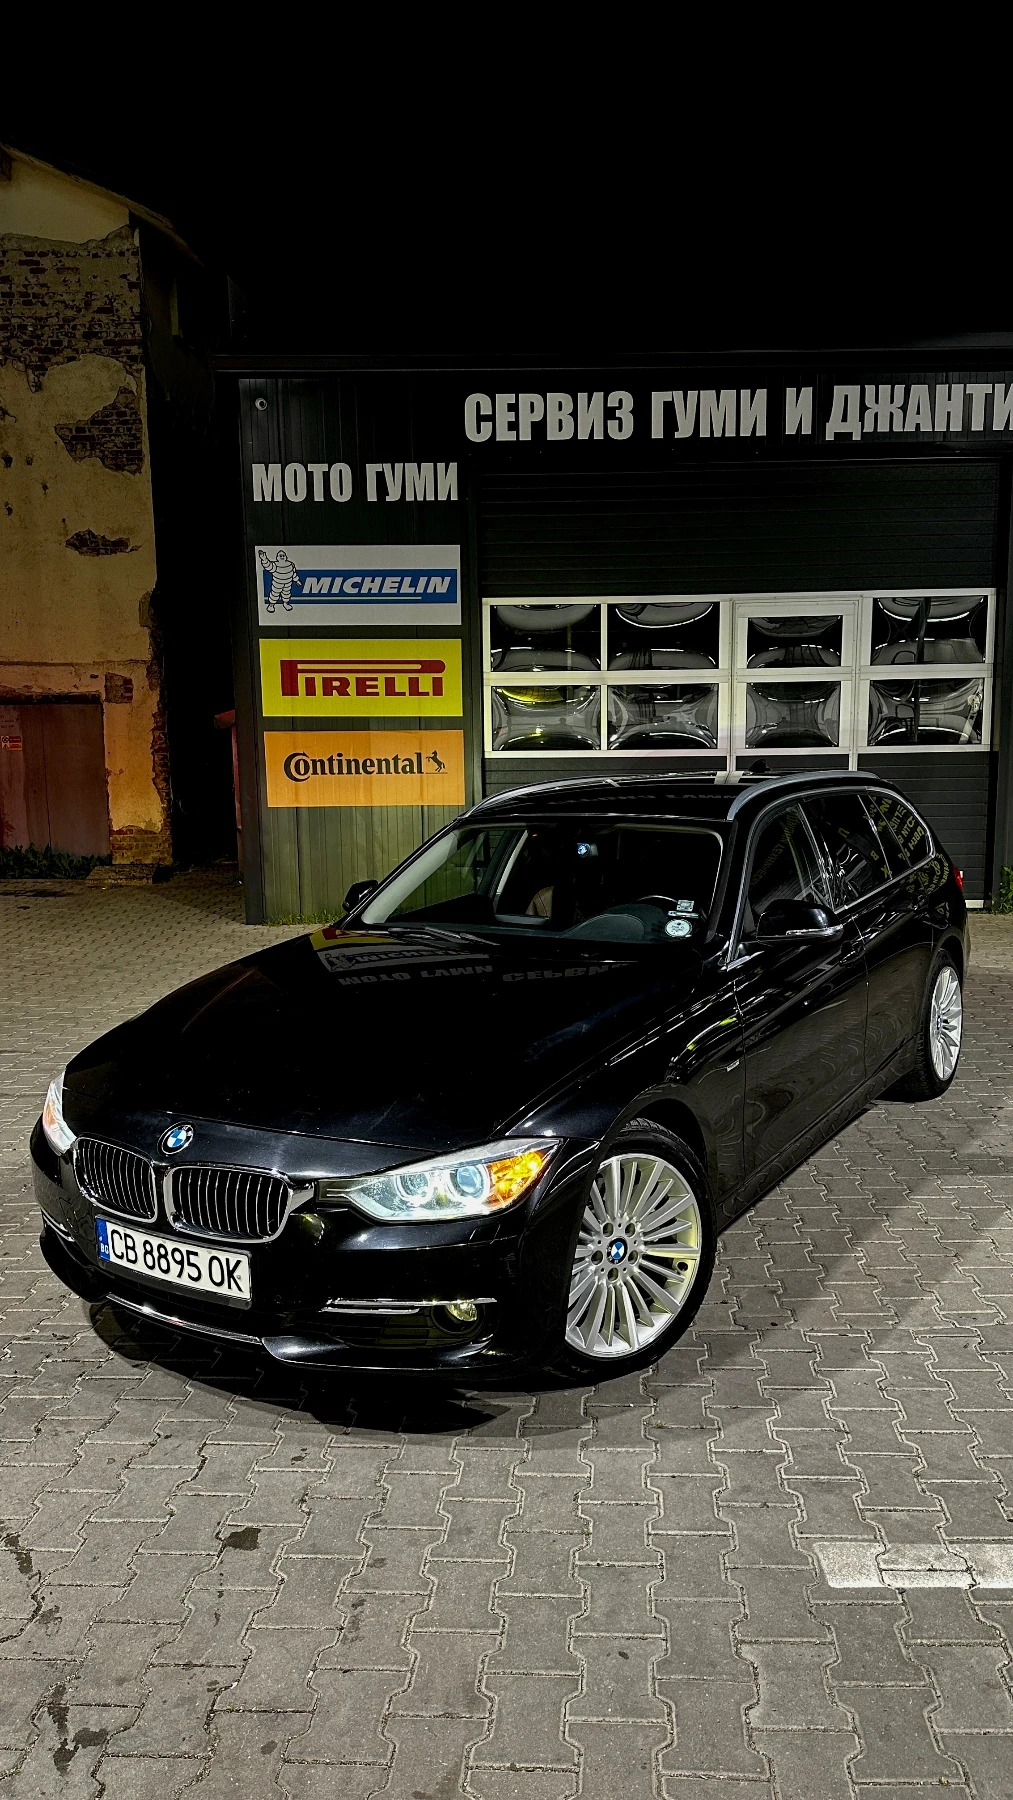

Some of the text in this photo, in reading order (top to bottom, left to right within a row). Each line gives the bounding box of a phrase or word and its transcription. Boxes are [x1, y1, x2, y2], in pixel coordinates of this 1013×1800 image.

[464, 383, 1013, 443] СЕРВИЗ ГУМИ И ДЖАНТИ
[251, 461, 458, 502] МОТО ГУМИ
[302, 576, 451, 594] MICHELIN
[280, 659, 446, 697] PIRELLI
[283, 751, 424, 783] Continental
[110, 1229, 244, 1293] CB 8895 OK
